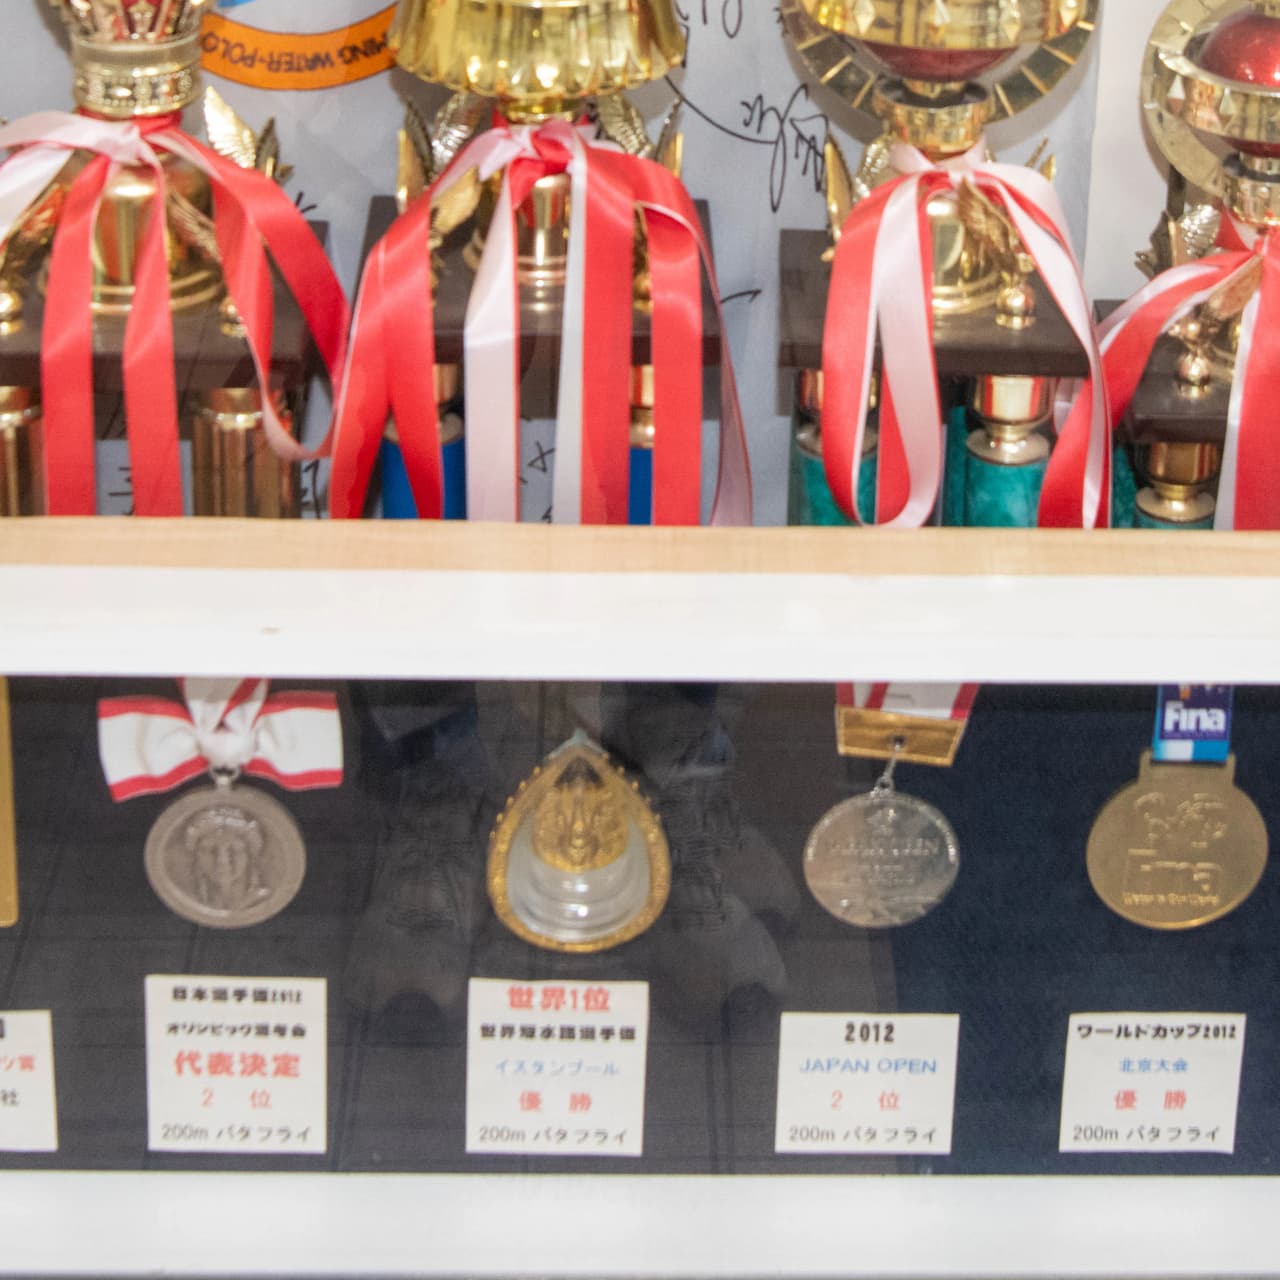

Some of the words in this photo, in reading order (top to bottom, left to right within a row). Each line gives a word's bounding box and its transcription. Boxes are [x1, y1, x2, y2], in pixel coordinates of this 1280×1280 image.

[201, 32, 334, 73] WATER-POLO
[508, 986, 609, 1012] 世界1位
[845, 1022, 895, 1043] 2012
[1078, 1024, 1236, 1039] ワールドカップ2012
[175, 1050, 300, 1078] 代表決定
[799, 1058, 869, 1073] JAPAN
[877, 1058, 937, 1073] OPEN
[1120, 1058, 1188, 1072] 北京大会
[1115, 1089, 1187, 1110] 優勝
[162, 1124, 208, 1140] 200m
[216, 1126, 311, 1143] バタフライ
[479, 1126, 526, 1143] 200m
[533, 1128, 627, 1145] バタフライ
[789, 1126, 835, 1142] 200m
[843, 1127, 936, 1143] バタフライ
[1073, 1125, 1118, 1141] 200m
[1127, 1126, 1219, 1142] バタフライ
